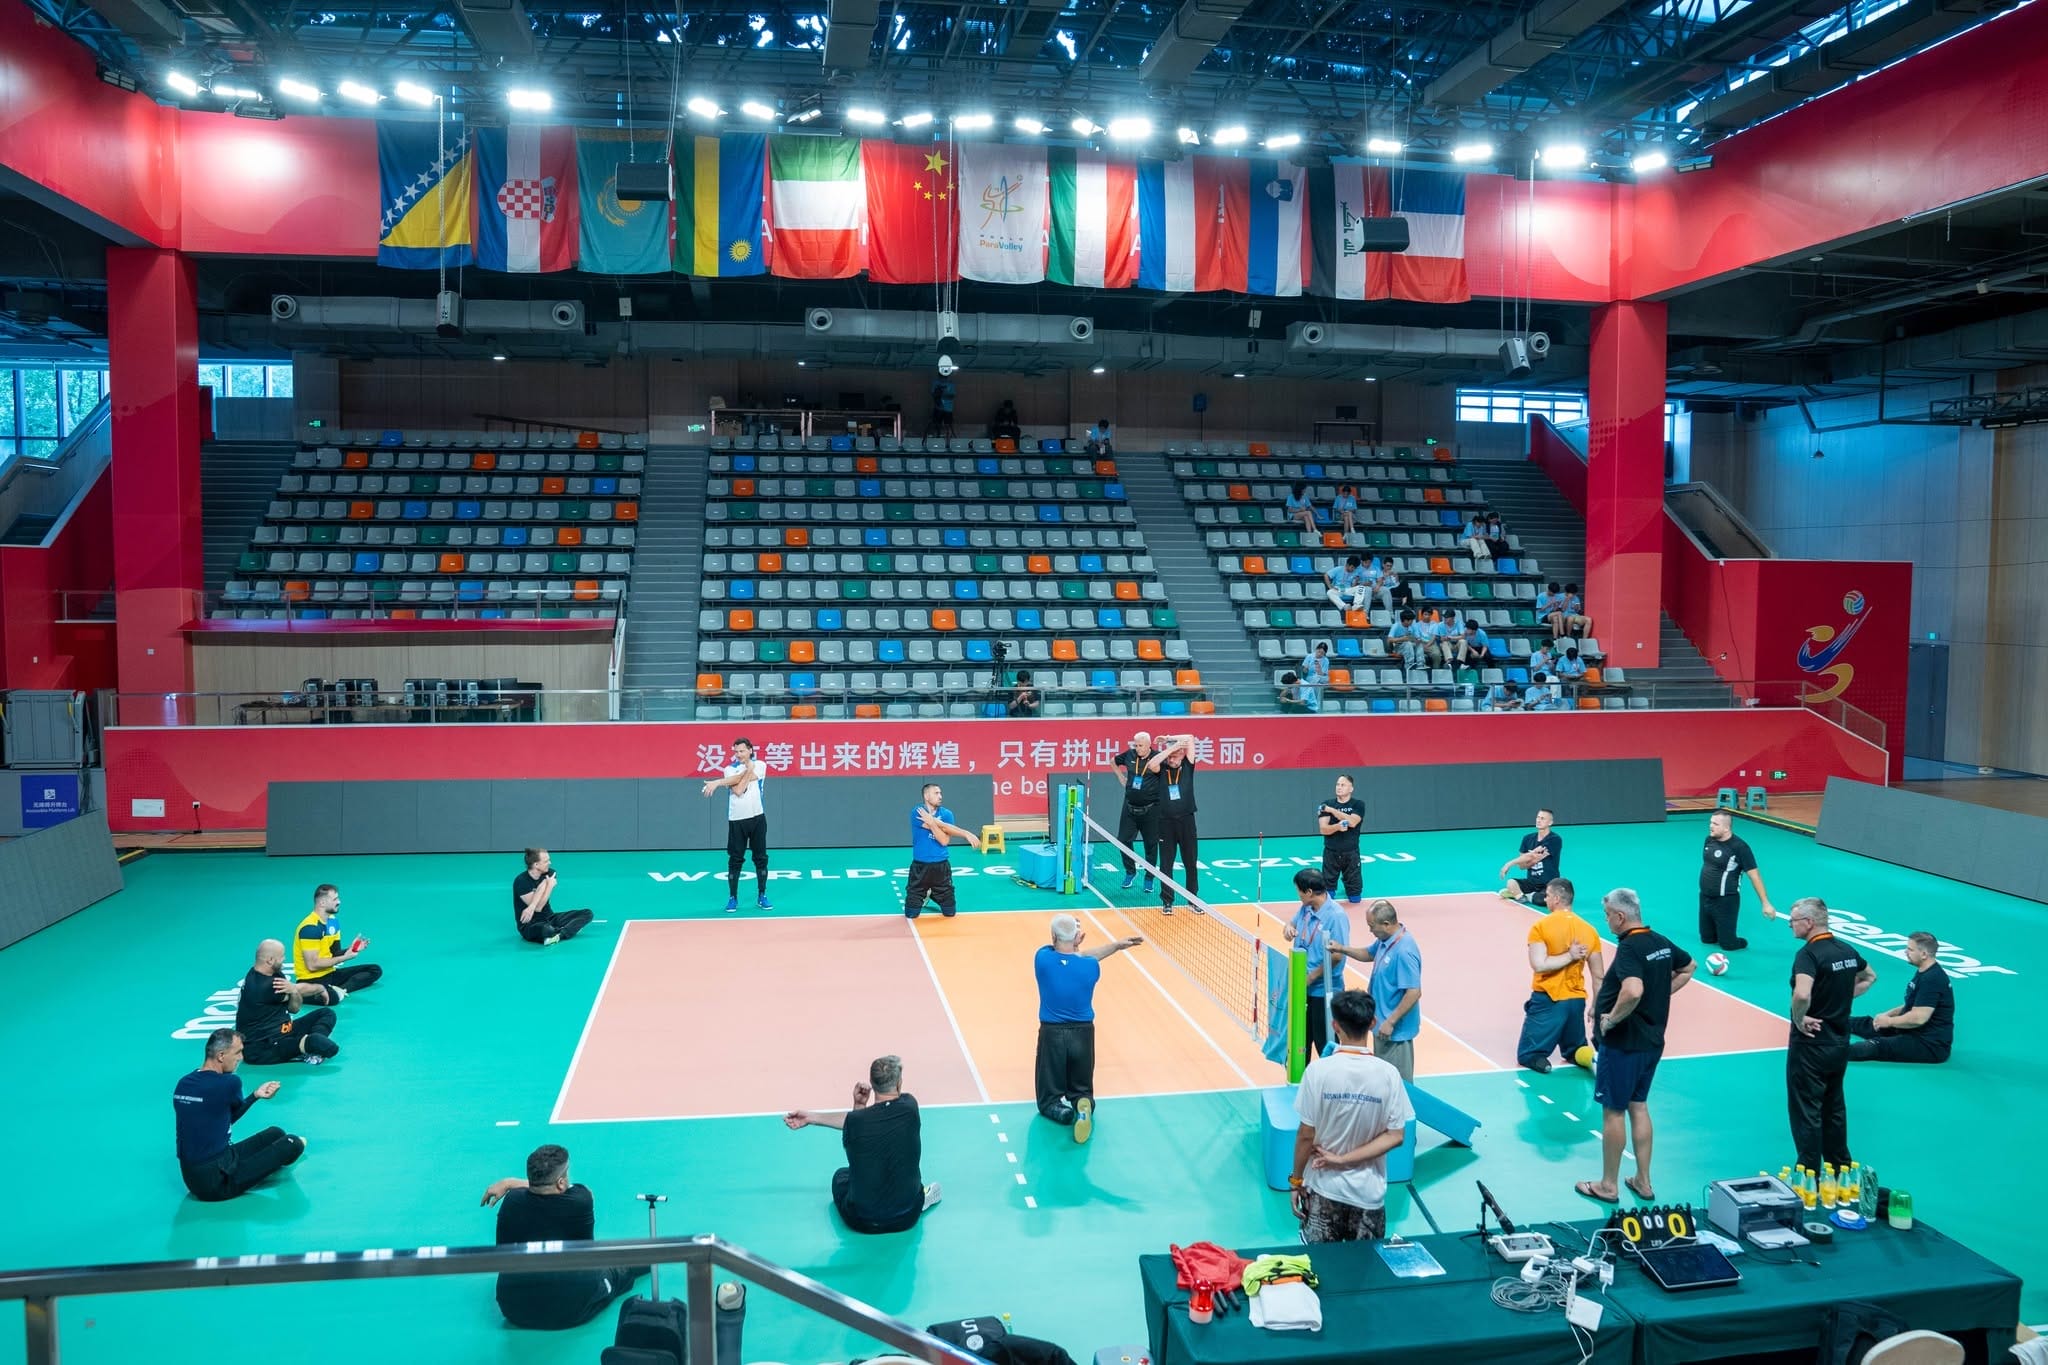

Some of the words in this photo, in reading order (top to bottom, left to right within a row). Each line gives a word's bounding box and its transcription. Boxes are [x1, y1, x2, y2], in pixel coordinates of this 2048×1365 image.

[980, 239, 1023, 252] ParaVolley
[696, 736, 1265, 773] 没等出来的辉煌，只有拼出美丽。
[1622, 1216, 1642, 1242] 0
[1667, 1212, 1687, 1238] 0
